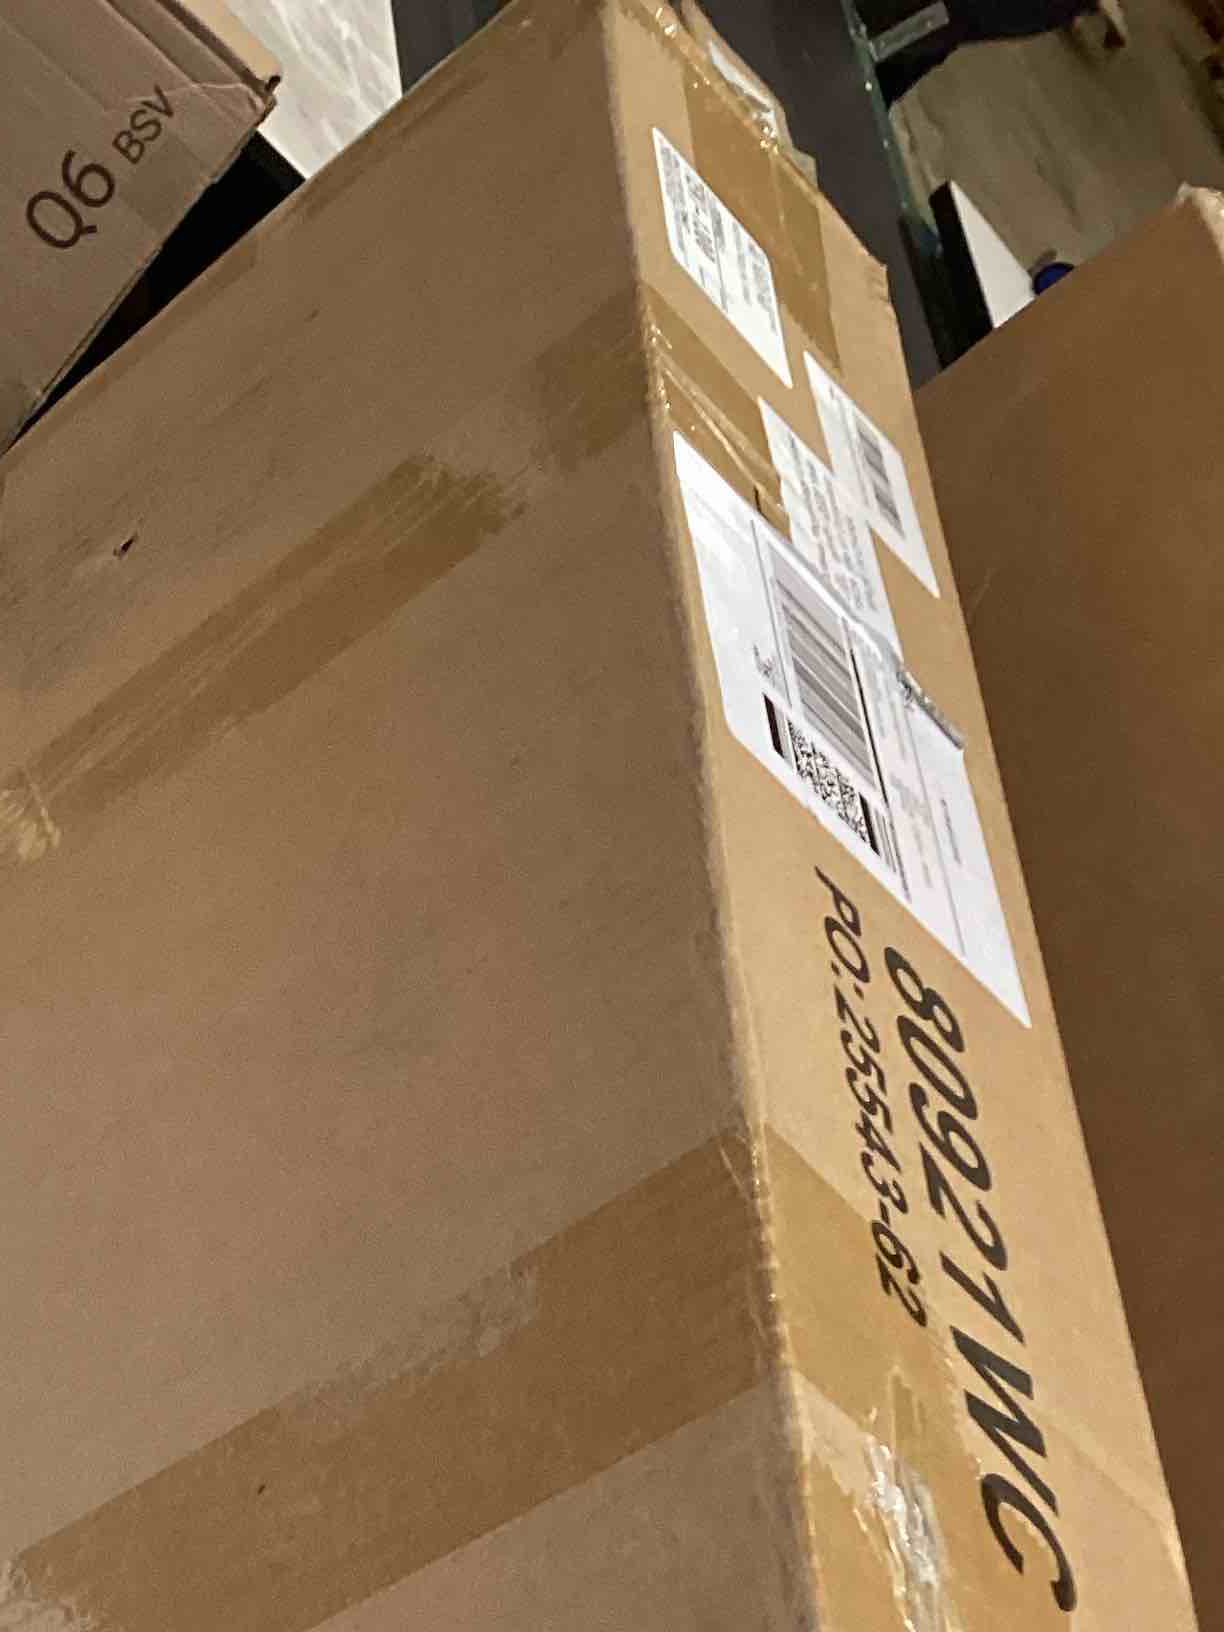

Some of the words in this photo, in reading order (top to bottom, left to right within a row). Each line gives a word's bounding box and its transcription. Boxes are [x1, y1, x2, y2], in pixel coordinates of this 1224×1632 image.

[26, 150, 115, 249] Q6
[113, 85, 175, 164] BSV
[815, 865, 929, 1329] PO:25543-62
[884, 945, 1078, 1614] 80921WC
